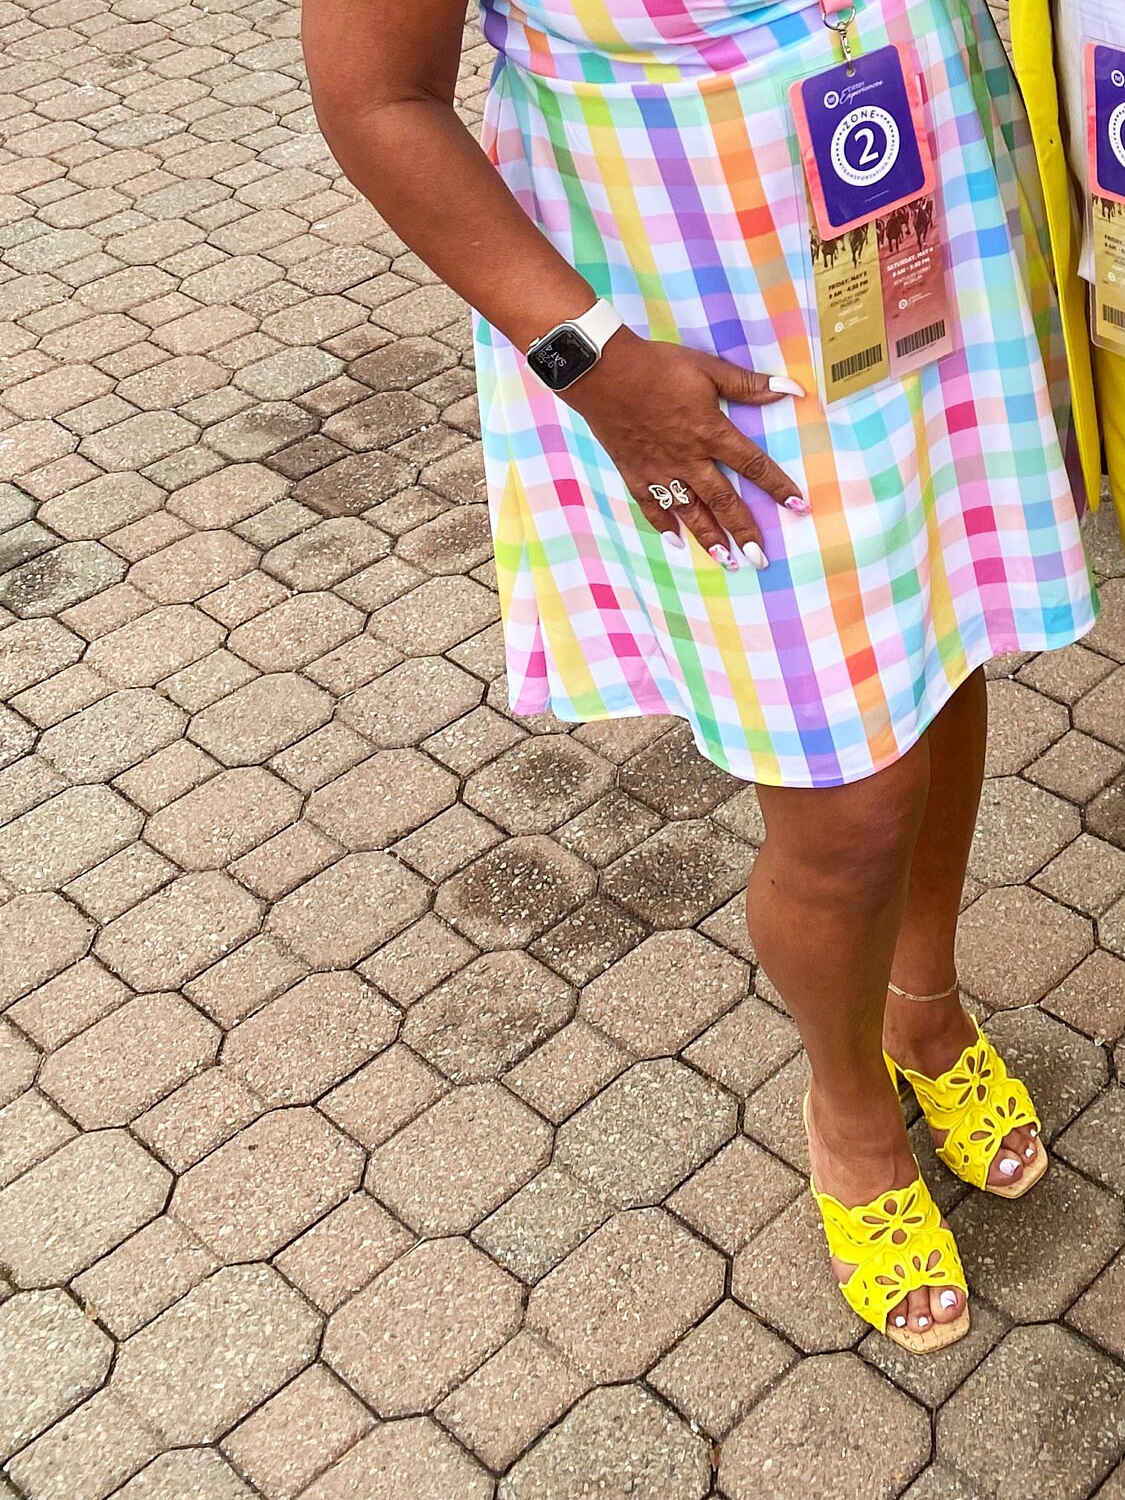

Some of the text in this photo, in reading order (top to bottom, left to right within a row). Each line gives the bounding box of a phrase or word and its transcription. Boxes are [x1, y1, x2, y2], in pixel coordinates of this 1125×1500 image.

[843, 109, 876, 130] ZONE
[854, 128, 879, 165] 2
[551, 351, 567, 367] SAT
